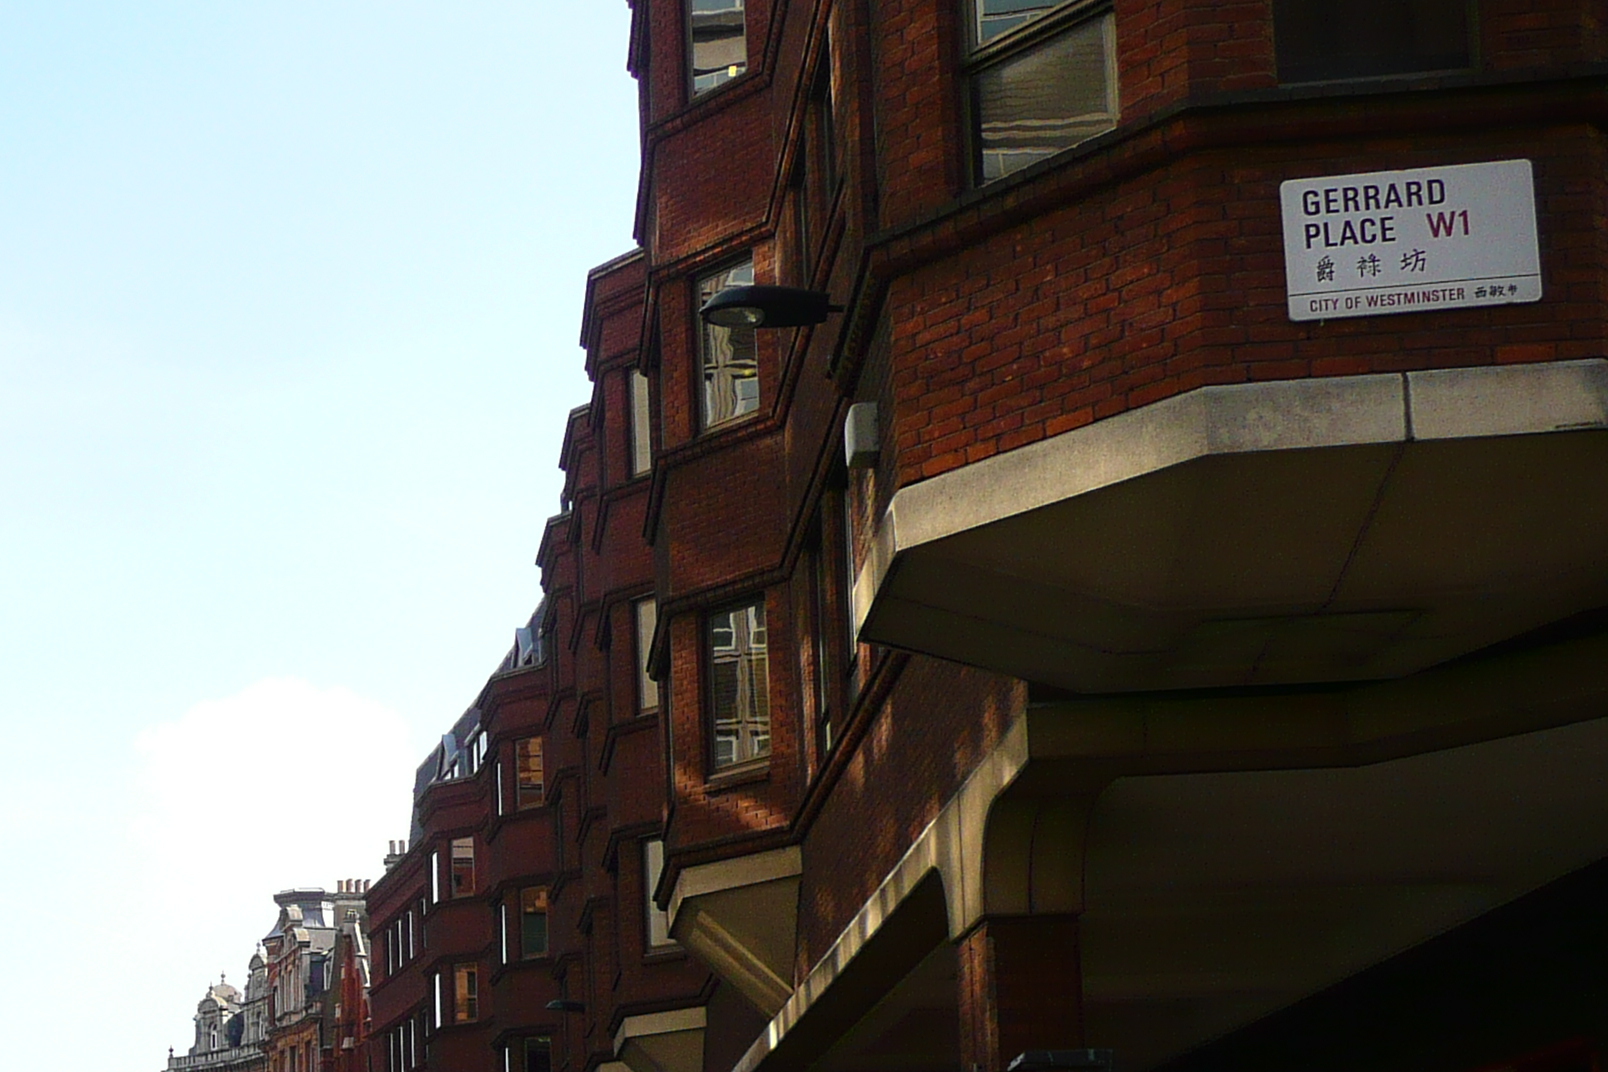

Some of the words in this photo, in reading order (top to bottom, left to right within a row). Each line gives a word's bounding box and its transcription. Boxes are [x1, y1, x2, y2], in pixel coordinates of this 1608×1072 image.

[1302, 179, 1446, 216] GERRARD
[1304, 216, 1397, 249] PLACE
[1426, 209, 1470, 238] W1
[1310, 298, 1339, 312] CITY
[1345, 296, 1362, 310] OF
[1366, 287, 1465, 308] WESTMINSTER
